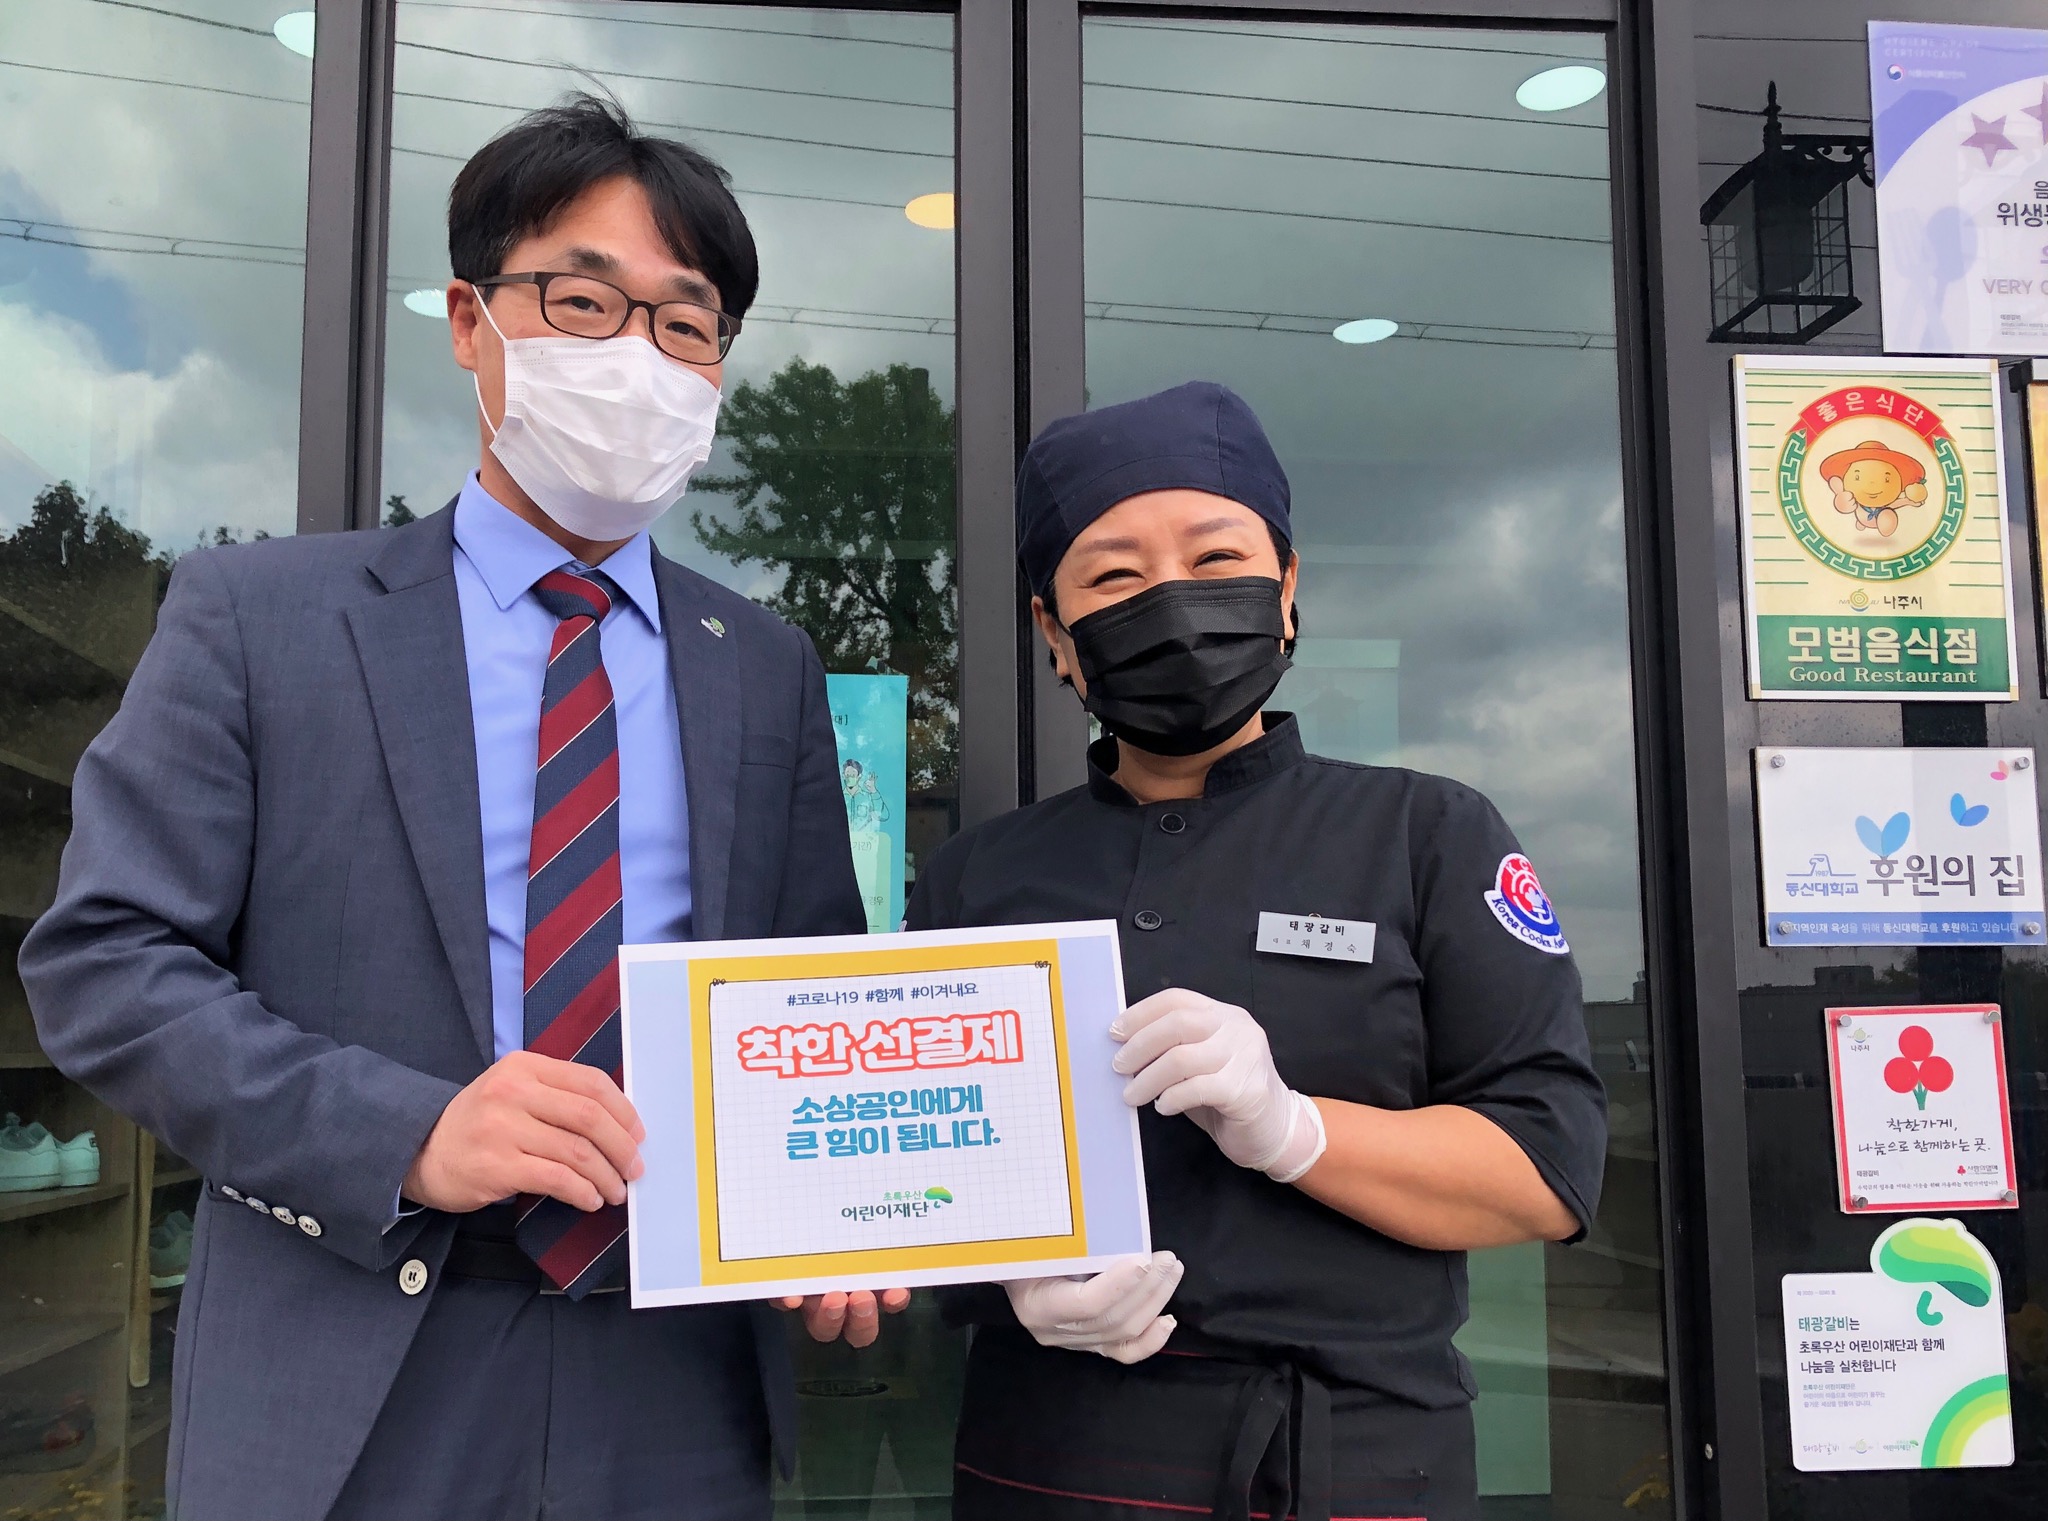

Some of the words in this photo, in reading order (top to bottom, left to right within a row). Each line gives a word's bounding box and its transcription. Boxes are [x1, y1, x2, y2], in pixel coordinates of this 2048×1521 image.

[1996, 202, 2048, 228] 위생
[1982, 278, 2033, 296] VERY
[1883, 595, 1923, 610] 나주시
[1787, 625, 1978, 665] 모범음식점
[1789, 666, 1846, 683] Good
[1854, 667, 1977, 685] Restaurant
[1785, 881, 1859, 897] 동신대학교
[1866, 854, 1976, 897] 후원의
[1989, 854, 2026, 897] 집
[1492, 897, 1519, 930] Korea
[1520, 926, 1552, 948] Cooks
[1793, 922, 1828, 934] 지역인재
[1830, 922, 1858, 934] 육성을
[1861, 922, 1880, 934] 위해
[1882, 922, 1939, 934] 동신대학교를
[1941, 922, 1979, 934] 후원하고
[787, 990, 859, 1007] #코로나19
[865, 986, 904, 1003] #함께
[911, 982, 979, 1000] #이겨내요
[792, 1084, 983, 1125] 소상공인에게
[1887, 1117, 1958, 1133] 착한가게,
[786, 1130, 820, 1160] 큰
[825, 1125, 890, 1157] 힘이
[897, 1118, 1001, 1151] 됩니다.
[1858, 1139, 1910, 1156] 나눔으로
[1913, 1139, 1970, 1152] 함께하는
[1974, 1137, 1991, 1152] 곳.
[883, 1190, 923, 1202] 초록우산
[841, 1201, 929, 1222] 어린이재단
[1798, 1316, 1860, 1332] 태광갈비는
[1799, 1340, 1845, 1354] 초록우산
[1849, 1338, 1918, 1353] 어린이재단과
[1921, 1338, 1945, 1351] 함께
[1800, 1360, 1835, 1374] 나눔을
[1839, 1359, 1897, 1373] 실천합니다
